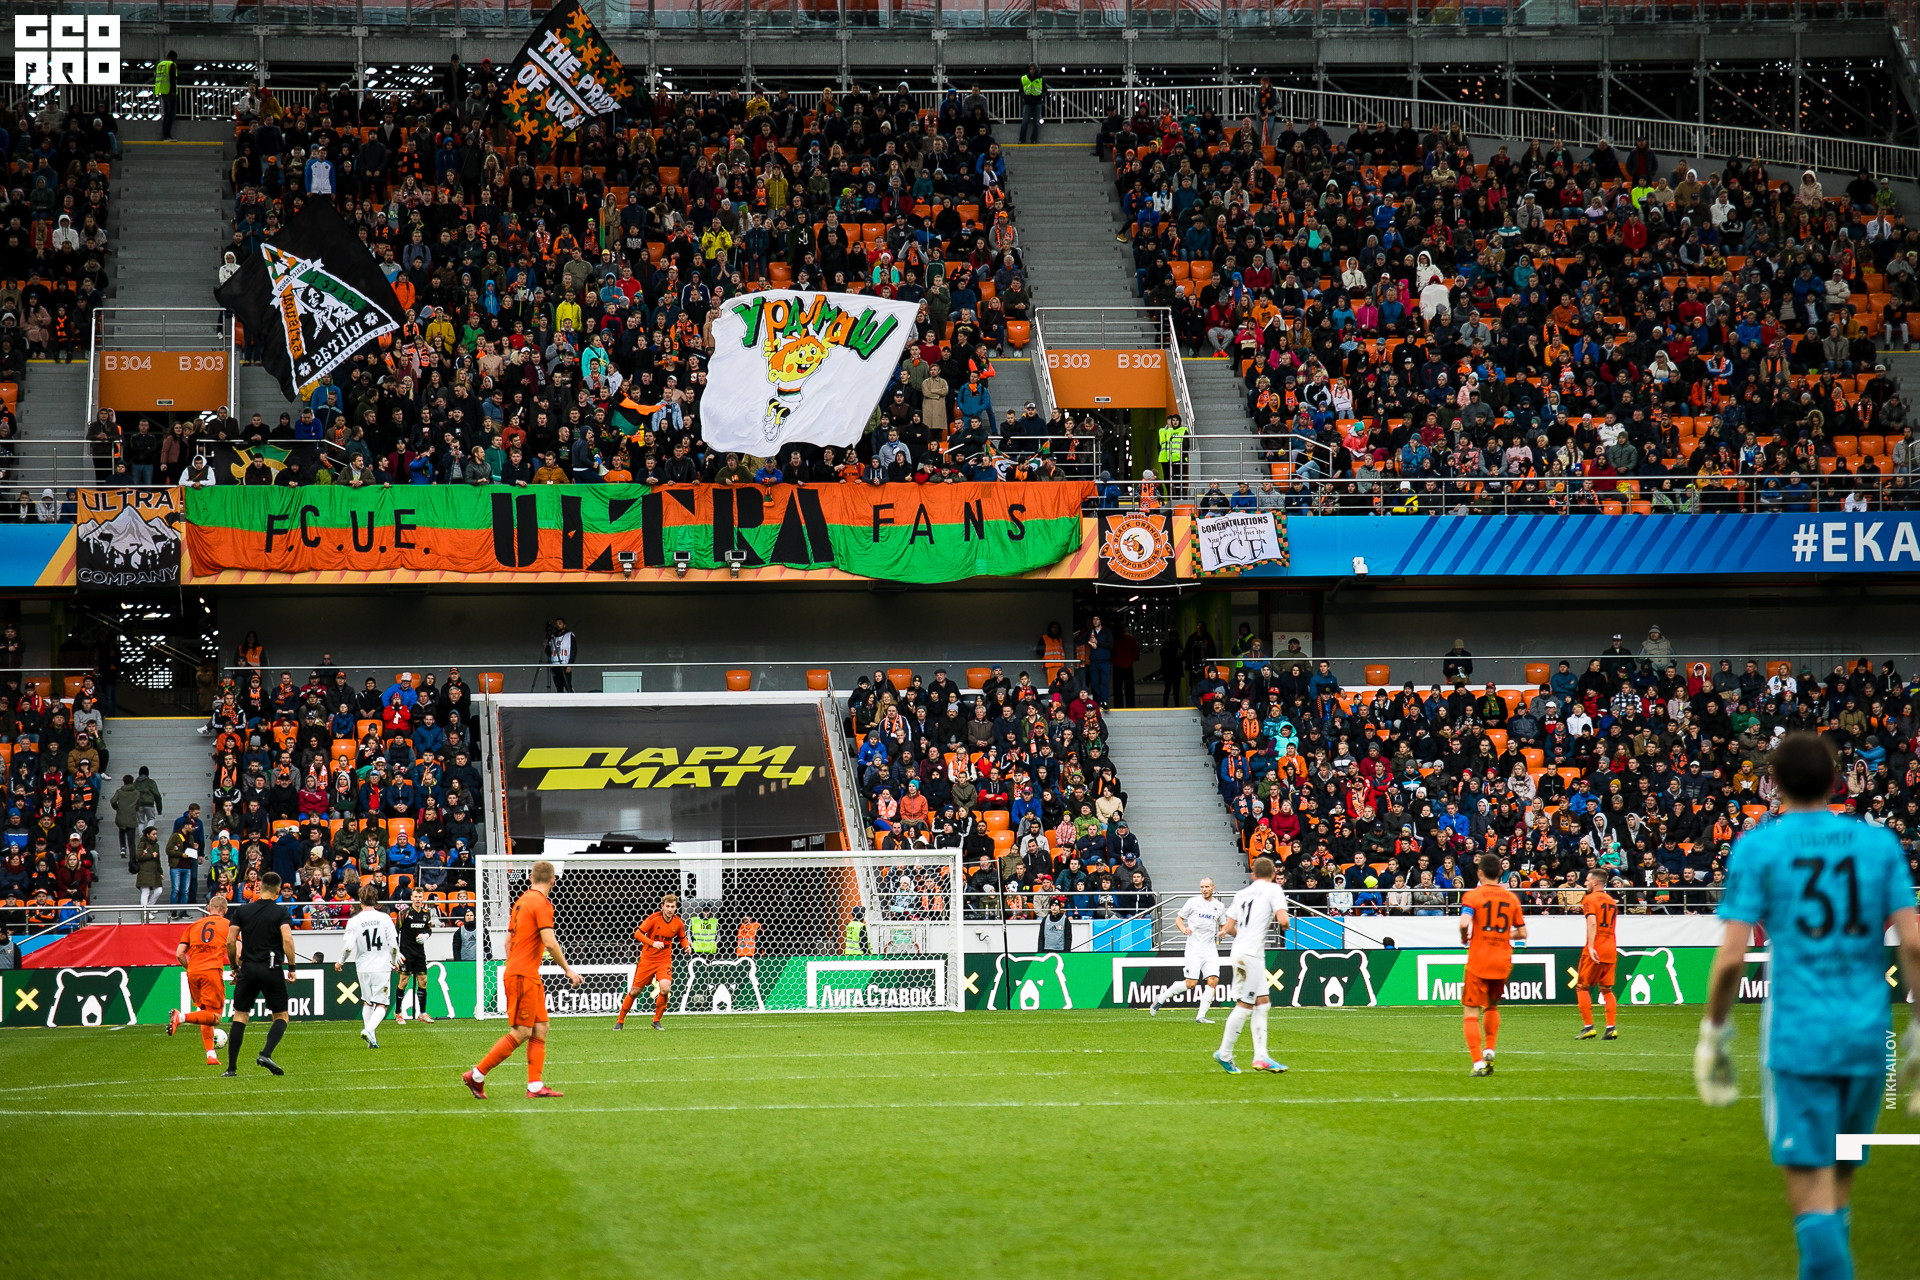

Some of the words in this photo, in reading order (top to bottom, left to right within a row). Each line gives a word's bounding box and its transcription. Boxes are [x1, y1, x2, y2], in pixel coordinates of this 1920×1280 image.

[538, 30, 582, 79] THE
[517, 64, 551, 92] OF
[104, 355, 118, 371] B
[120, 355, 152, 371] 304
[179, 355, 192, 371] B
[194, 355, 224, 371] 303
[1047, 354, 1060, 369] B
[1062, 354, 1091, 369] 303
[1118, 354, 1130, 369] B
[1132, 354, 1162, 369] 302
[82, 490, 175, 512] ULTRA
[873, 499, 1026, 545] FANS
[1113, 522, 1131, 543] BLACK
[1135, 521, 1161, 544] ORANGE
[1201, 516, 1269, 534] CONGRATULATIONS
[1210, 537, 1268, 566] ICF
[1792, 522, 1920, 562] #EKA
[1114, 549, 1160, 569] SUPPORTERS
[77, 565, 179, 586] COMPANY
[517, 745, 797, 769] ПАРИ
[536, 765, 815, 791] МАТЧ
[1792, 856, 1869, 939] 31
[1482, 900, 1510, 934] 15
[1600, 902, 1616, 929] 17
[201, 921, 215, 943] 6
[362, 927, 383, 952] 14
[1431, 978, 1465, 1000] ЛИГ
[1501, 981, 1543, 1000] АВОК
[1738, 976, 1771, 998] ЛИГ
